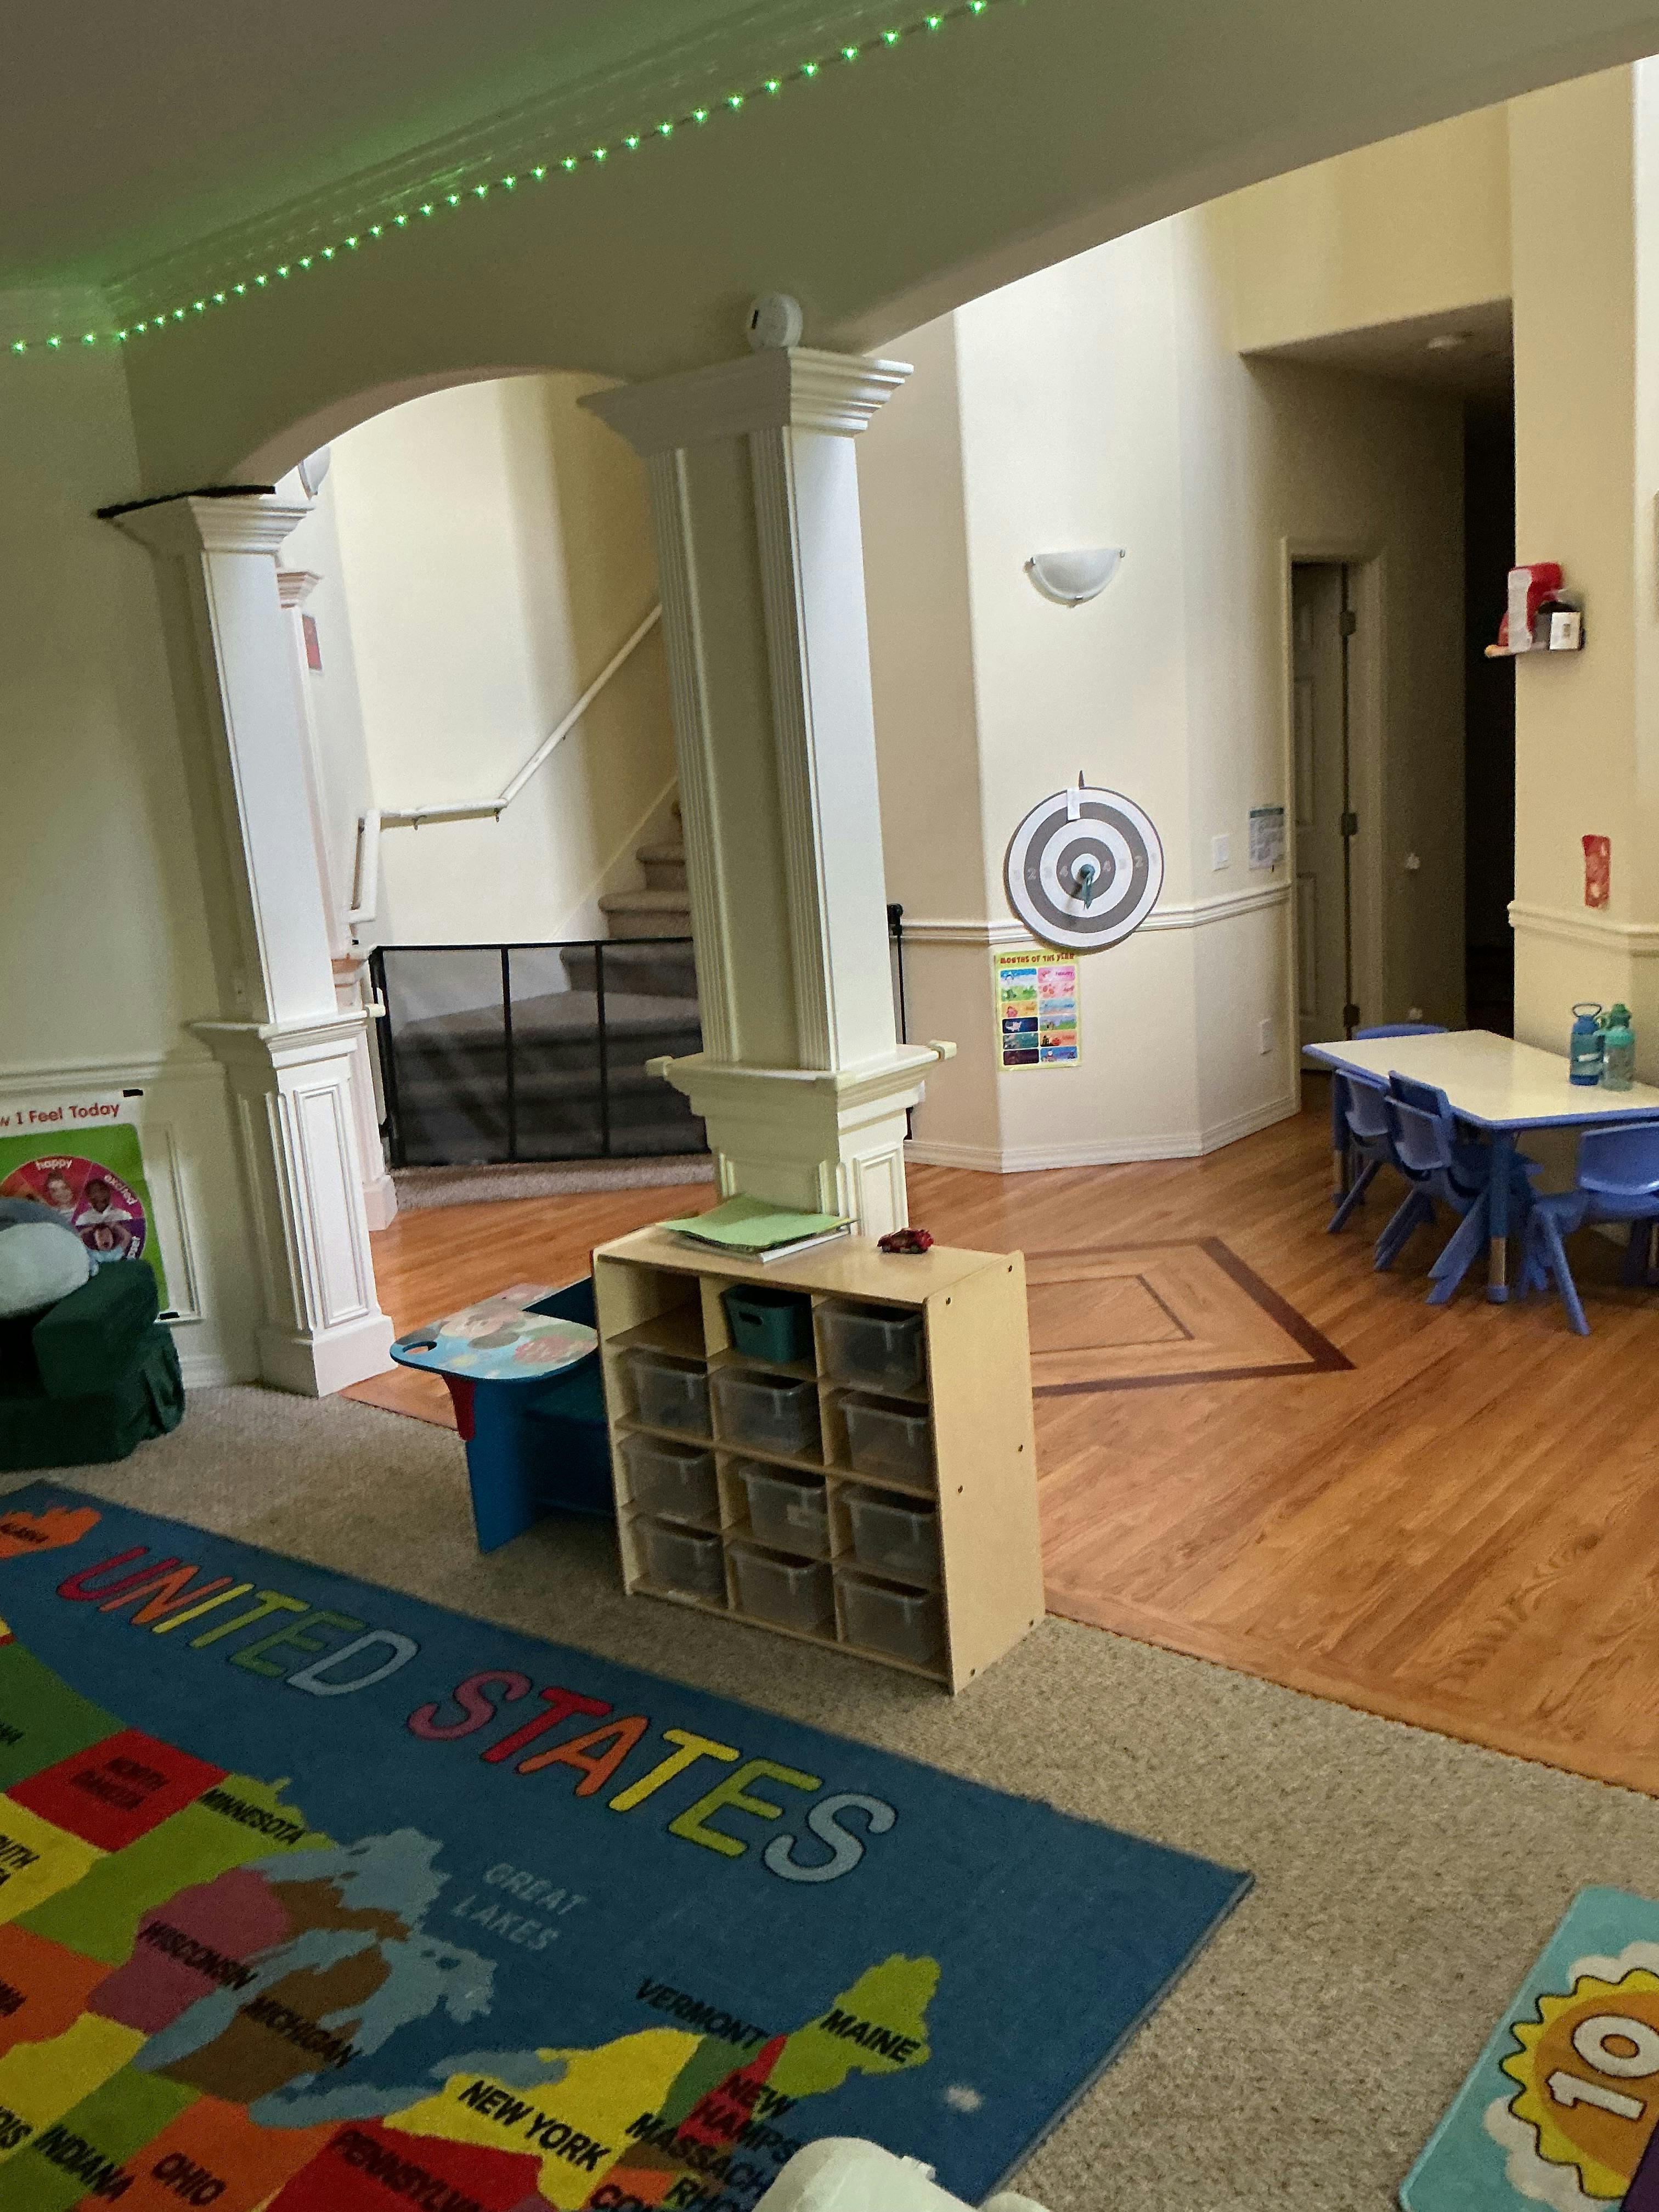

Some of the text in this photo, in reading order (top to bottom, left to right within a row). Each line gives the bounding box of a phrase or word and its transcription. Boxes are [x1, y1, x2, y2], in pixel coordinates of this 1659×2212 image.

[1134, 855, 1144, 868] 2
[1000, 955, 1029, 964] MONTHS
[16, 1112, 23, 1125] I
[29, 1107, 63, 1124] Feel
[69, 1103, 120, 1119] Today
[36, 1158, 73, 1171] happy
[57, 1546, 897, 1883] UNITED STATES
[483, 1863, 588, 1916] GREAT
[451, 1894, 561, 1951] LAKES
[137, 1920, 259, 1991] WISCONSIN
[239, 1996, 363, 2069] MICHIGAN
[635, 1978, 771, 2050] VERMONT
[820, 2008, 921, 2064] MAINE
[715, 2073, 799, 2120] NEW
[1546, 2015, 1659, 2123] 10
[458, 2079, 612, 2171] NEW YORK
[32, 2124, 137, 2204] INDIANA
[151, 2152, 227, 2207] OHIO
